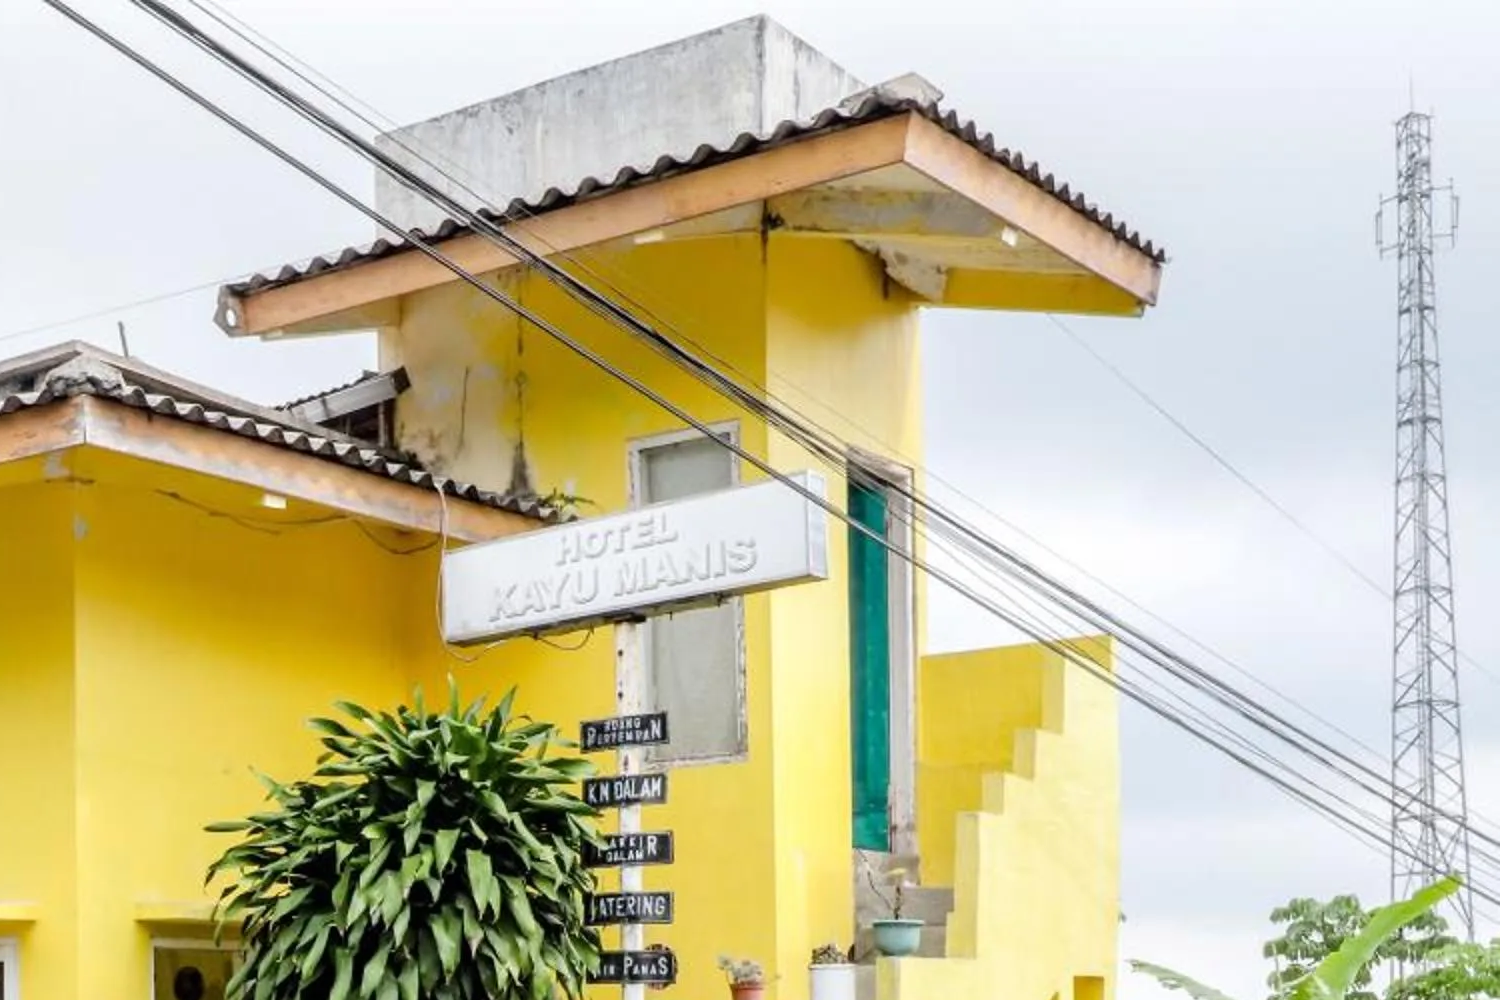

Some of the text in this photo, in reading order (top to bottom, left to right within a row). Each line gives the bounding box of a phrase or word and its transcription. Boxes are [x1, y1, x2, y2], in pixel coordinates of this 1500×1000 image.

[556, 510, 679, 567] HOTEL
[489, 537, 759, 622] KAYU MANIS
[614, 777, 662, 800] DALAM
[606, 849, 644, 862] DALAM
[591, 895, 666, 920] ATERING
[624, 957, 668, 975] PANAS
